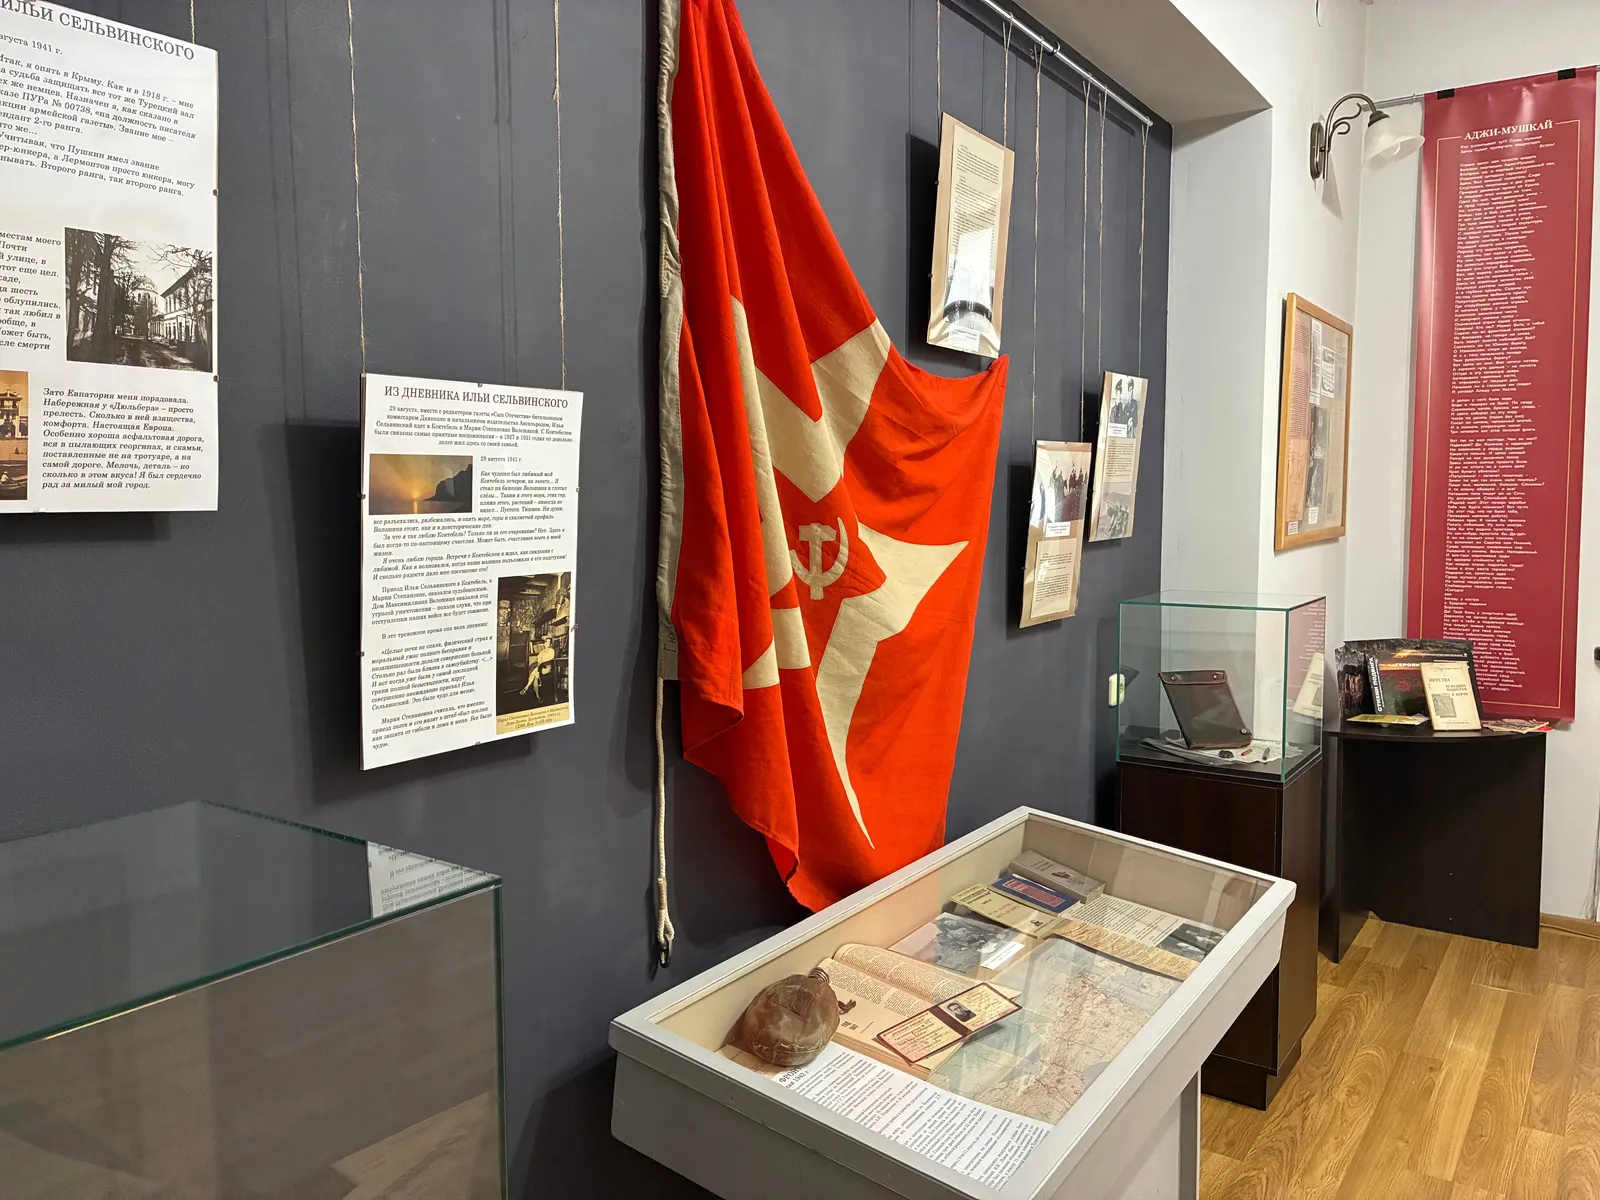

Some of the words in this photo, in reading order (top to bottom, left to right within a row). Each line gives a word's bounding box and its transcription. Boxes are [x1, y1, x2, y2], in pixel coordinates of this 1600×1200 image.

[59, 12, 195, 61] СЕЛЬВИНСКОГО
[32, 40, 53, 53] 1941
[9, 69, 41, 82] судьба
[43, 77, 90, 93] защищать
[92, 88, 106, 97] все
[107, 92, 123, 101] тот
[123, 96, 136, 105] же
[138, 97, 179, 115] Турецкий
[180, 110, 195, 119] вал
[34, 64, 61, 76] опять
[71, 71, 104, 87] Крыму.
[106, 80, 124, 91] Как
[142, 89, 161, 100] 1918
[178, 100, 194, 109] мне
[10, 80, 25, 89] же
[26, 84, 63, 98] немцев.
[66, 91, 110, 109] Назначен
[111, 104, 120, 112] я,
[121, 106, 138, 115] как
[139, 110, 172, 123] сказано
[0, 100, 27, 111] кции
[28, 106, 78, 122] армейской
[80, 117, 116, 131] газеты».
[118, 123, 150, 138] Звание
[151, 134, 167, 142] мое
[21, 91, 49, 106] ПУРа
[51, 98, 62, 108] №
[64, 101, 93, 116] 00738,
[95, 111, 110, 119] «на
[111, 114, 157, 130] должность
[159, 125, 196, 139] писателя
[33, 116, 53, 127] 2-го
[54, 122, 83, 134] ранга.
[1464, 119, 1553, 141] АДЖИ-МУШКАЙ
[50, 143, 66, 151] что
[67, 144, 105, 160] Пушкин
[106, 154, 129, 165] имел
[130, 160, 160, 171] звание
[40, 160, 77, 175] Второго
[78, 170, 107, 181] ранга,
[109, 176, 124, 184] так
[125, 179, 157, 191] второго
[158, 186, 184, 196] ранга.
[61, 154, 110, 171] Лермонтов
[112, 166, 140, 177] просто
[141, 172, 174, 185] юнкера,
[176, 180, 195, 190] могу
[35, 237, 62, 246] моего
[3, 296, 61, 310] облупились.
[4, 308, 21, 316] так
[22, 309, 54, 319] любил
[17, 341, 51, 351] смерти
[43, 387, 65, 397] Зато
[67, 389, 115, 401] Евпатория
[140, 396, 189, 404] порадовала.
[384, 385, 400, 397] ИЗ
[401, 387, 460, 401] ДНЕВНИКА
[462, 391, 491, 403] ИЛЬИ
[493, 394, 569, 409] СЕЛЬВИНСКОГО
[43, 398, 100, 409] Набережная
[101, 403, 108, 411] у
[109, 401, 160, 413] «Дюльбера»
[168, 407, 194, 415] просто
[43, 410, 86, 419] прелесть.
[89, 410, 126, 420] Сколько
[134, 413, 151, 421] ней
[152, 416, 196, 424] изящества,
[43, 419, 90, 430] комфорта.
[92, 420, 141, 431] Настоящая
[143, 423, 175, 433] Европа.
[43, 429, 86, 439] Особенно
[88, 432, 120, 441] хороша
[122, 432, 175, 442] асфальтовая
[176, 436, 205, 444] дорога,
[68, 442, 118, 450] пылающих
[119, 443, 164, 452] георгинах,
[173, 445, 204, 453] скамьи,
[42, 451, 107, 459] поставленные
[134, 453, 173, 462] тротуаре,
[42, 461, 70, 469] самой
[71, 462, 104, 470] дороге.
[106, 460, 141, 471] Мелочь,
[110, 471, 138, 480] вкуса!
[138, 471, 147, 479] Я
[148, 471, 165, 479] был
[166, 473, 202, 481] сердечно
[42, 482, 59, 490] рад
[73, 481, 105, 489] милый
